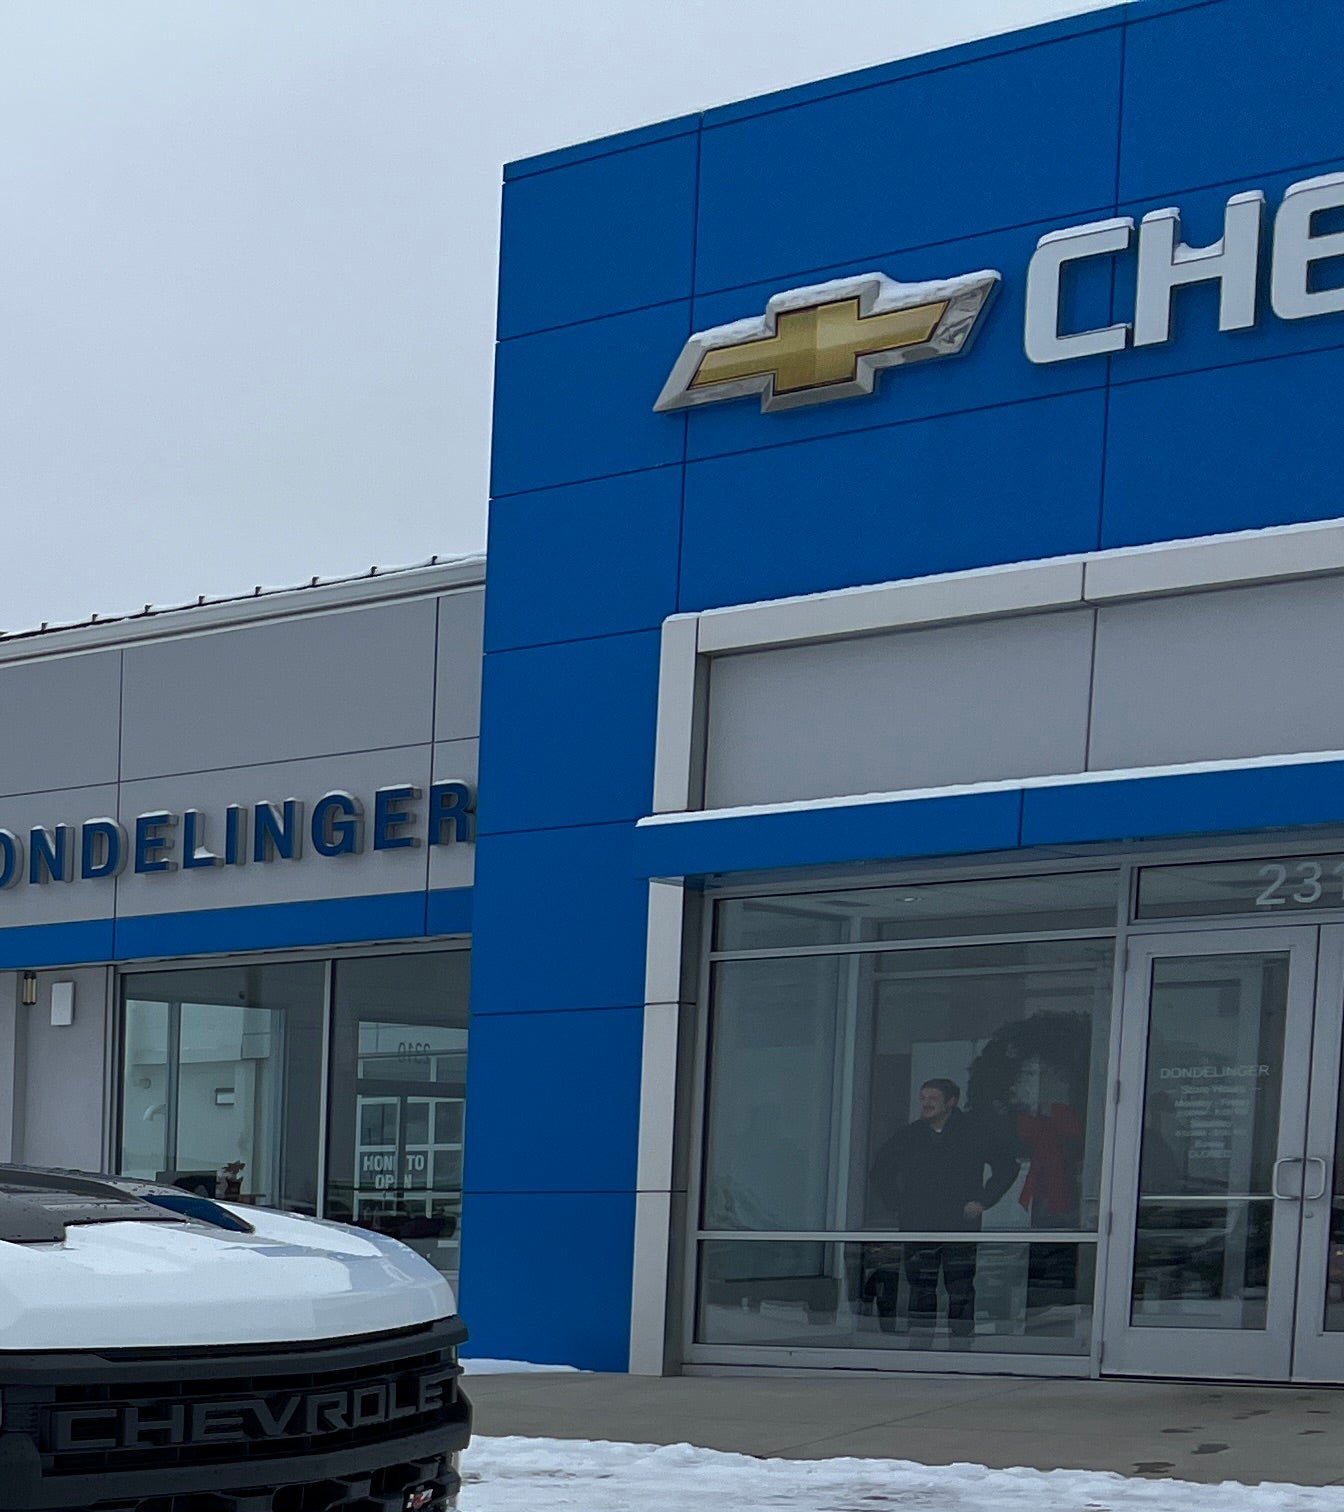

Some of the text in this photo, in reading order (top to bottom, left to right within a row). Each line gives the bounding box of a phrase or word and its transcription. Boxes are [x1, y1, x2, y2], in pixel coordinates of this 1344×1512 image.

[1159, 1064, 1270, 1079] DONDELINGER
[362, 1154, 425, 1172] HON TO
[375, 1174, 412, 1189] OPN
[53, 1366, 461, 1451] CHEVROLET
